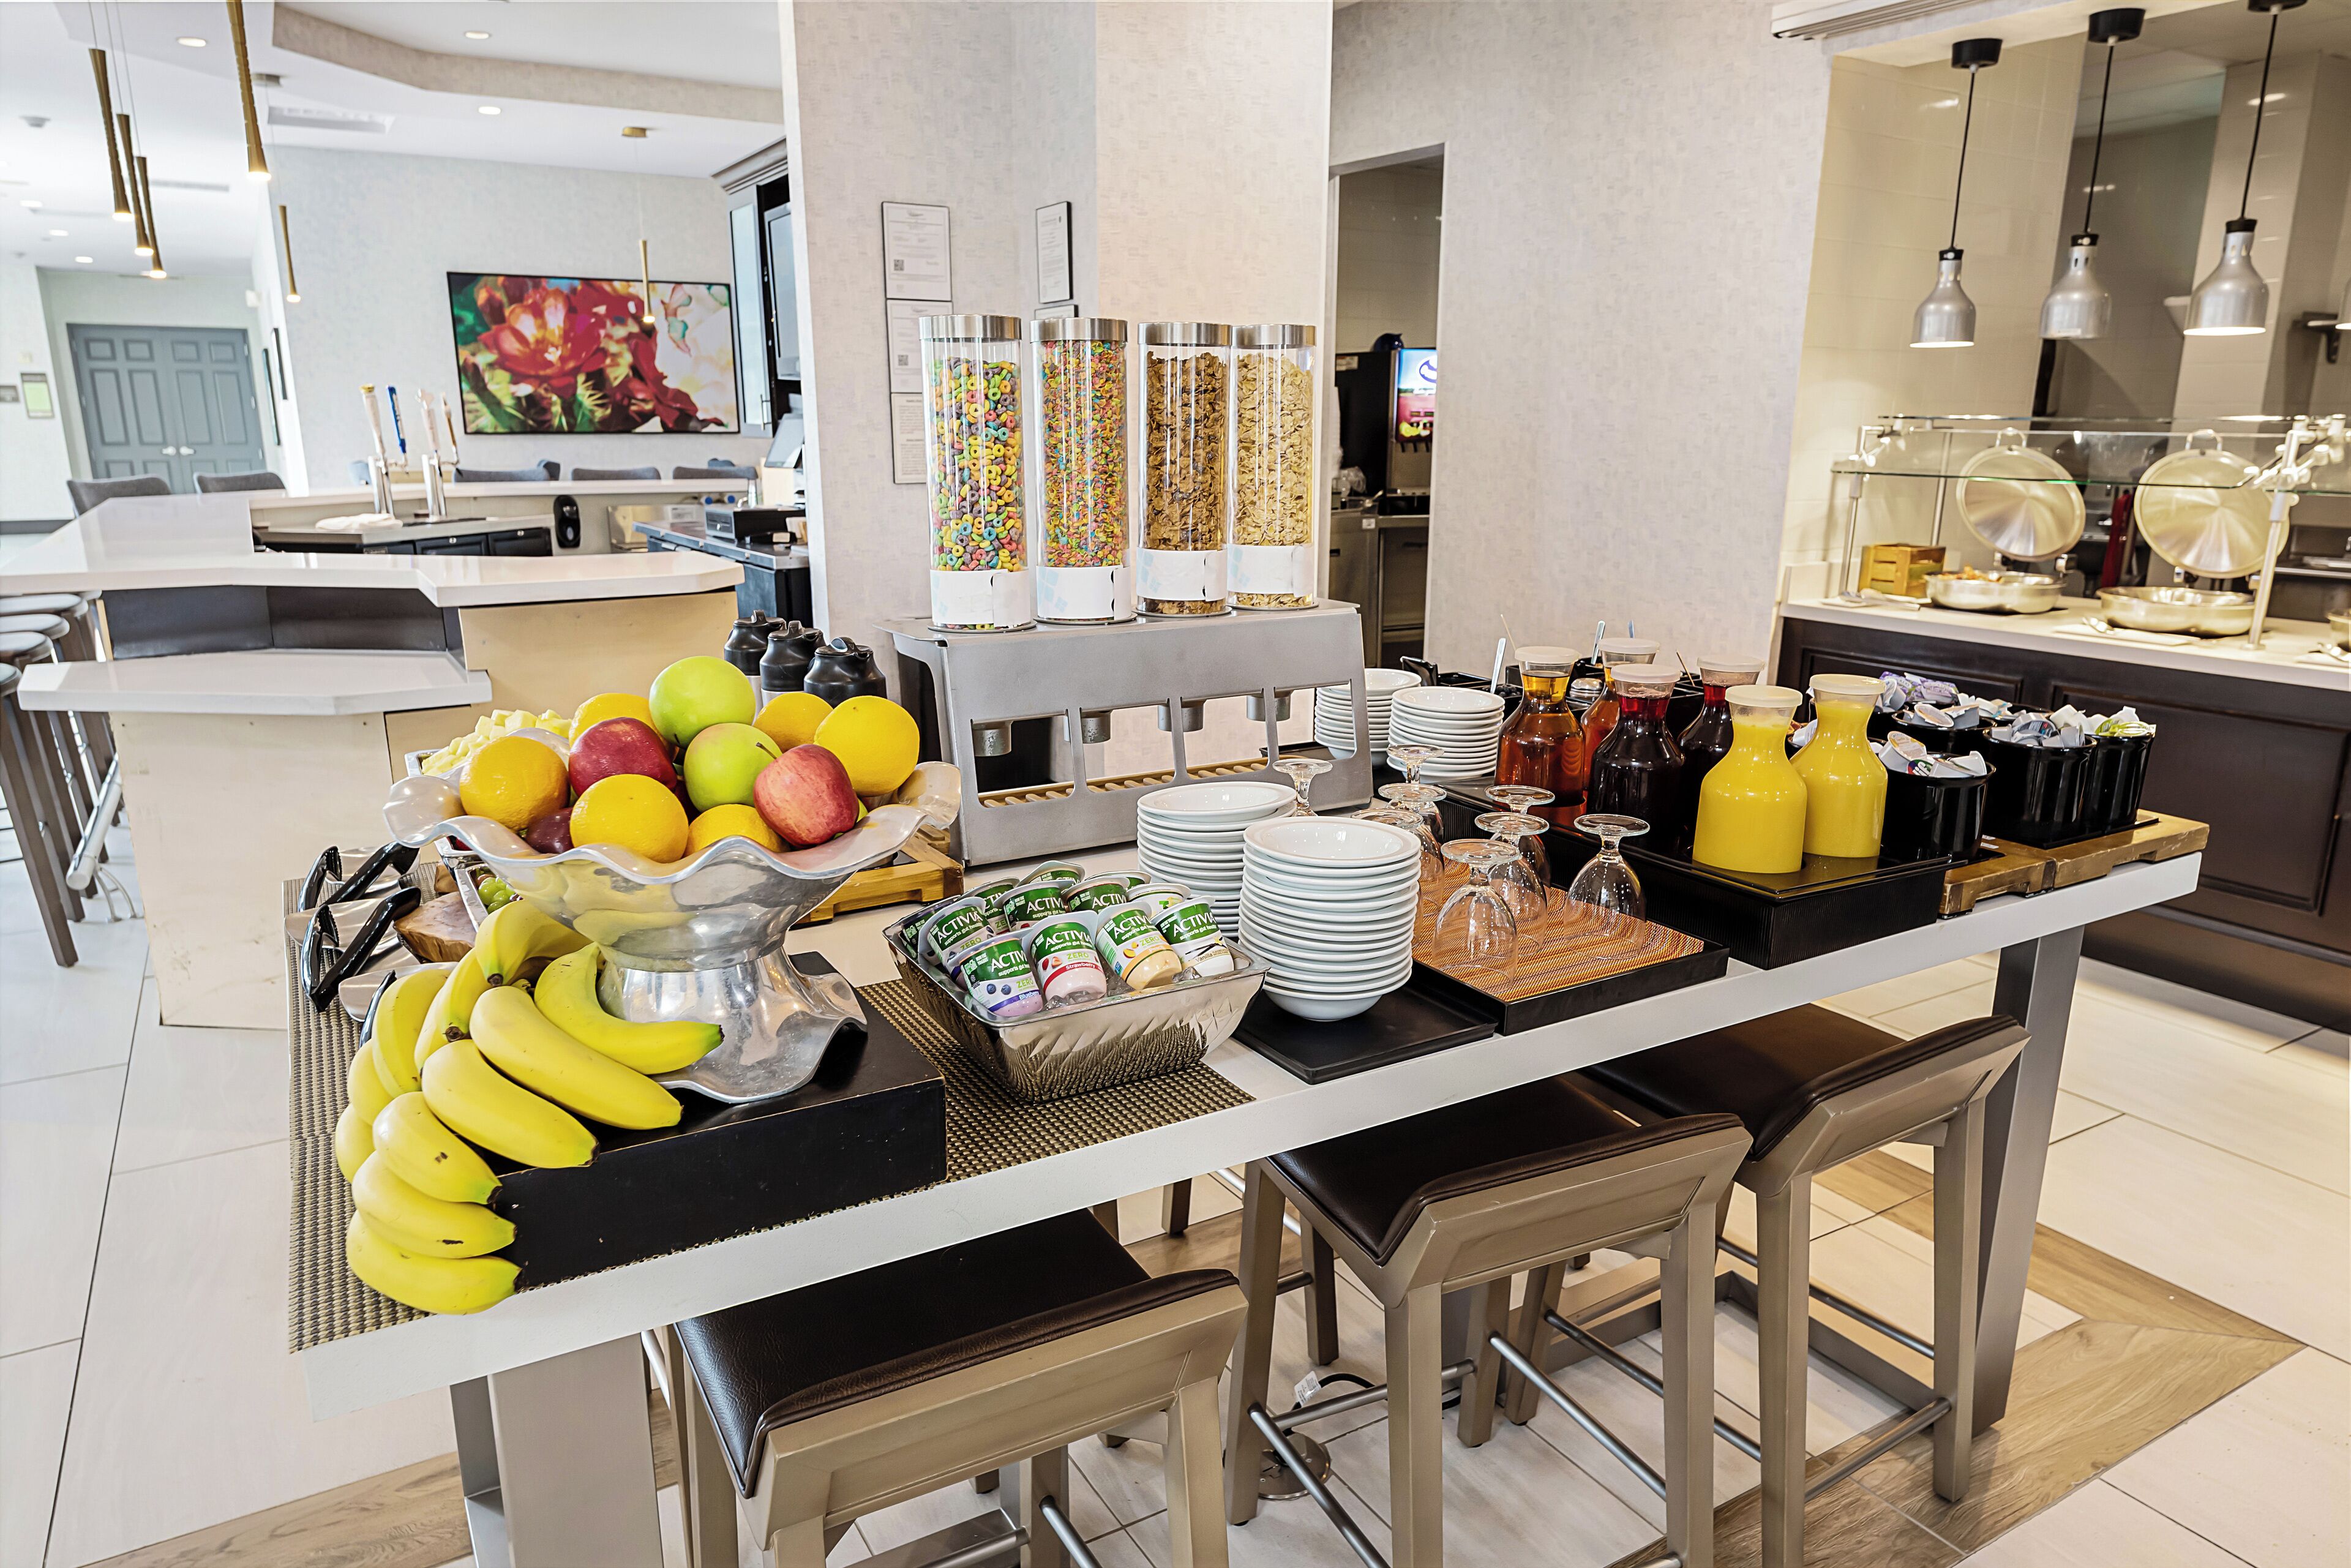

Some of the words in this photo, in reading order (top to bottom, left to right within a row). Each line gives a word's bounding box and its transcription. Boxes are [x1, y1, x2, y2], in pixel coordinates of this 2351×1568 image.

[937, 911, 983, 944] ACTIVIA
[1174, 912, 1217, 937] ACTIVIA
[944, 931, 962, 946] supports
[1180, 928, 1199, 940] supports
[960, 937, 982, 950] ZERO
[1051, 942, 1071, 951] supports
[1139, 936, 1160, 946] ZERO
[1195, 953, 1213, 962] Vanilla
[998, 966, 1018, 977] supports
[1016, 978, 1033, 989] ZERO
